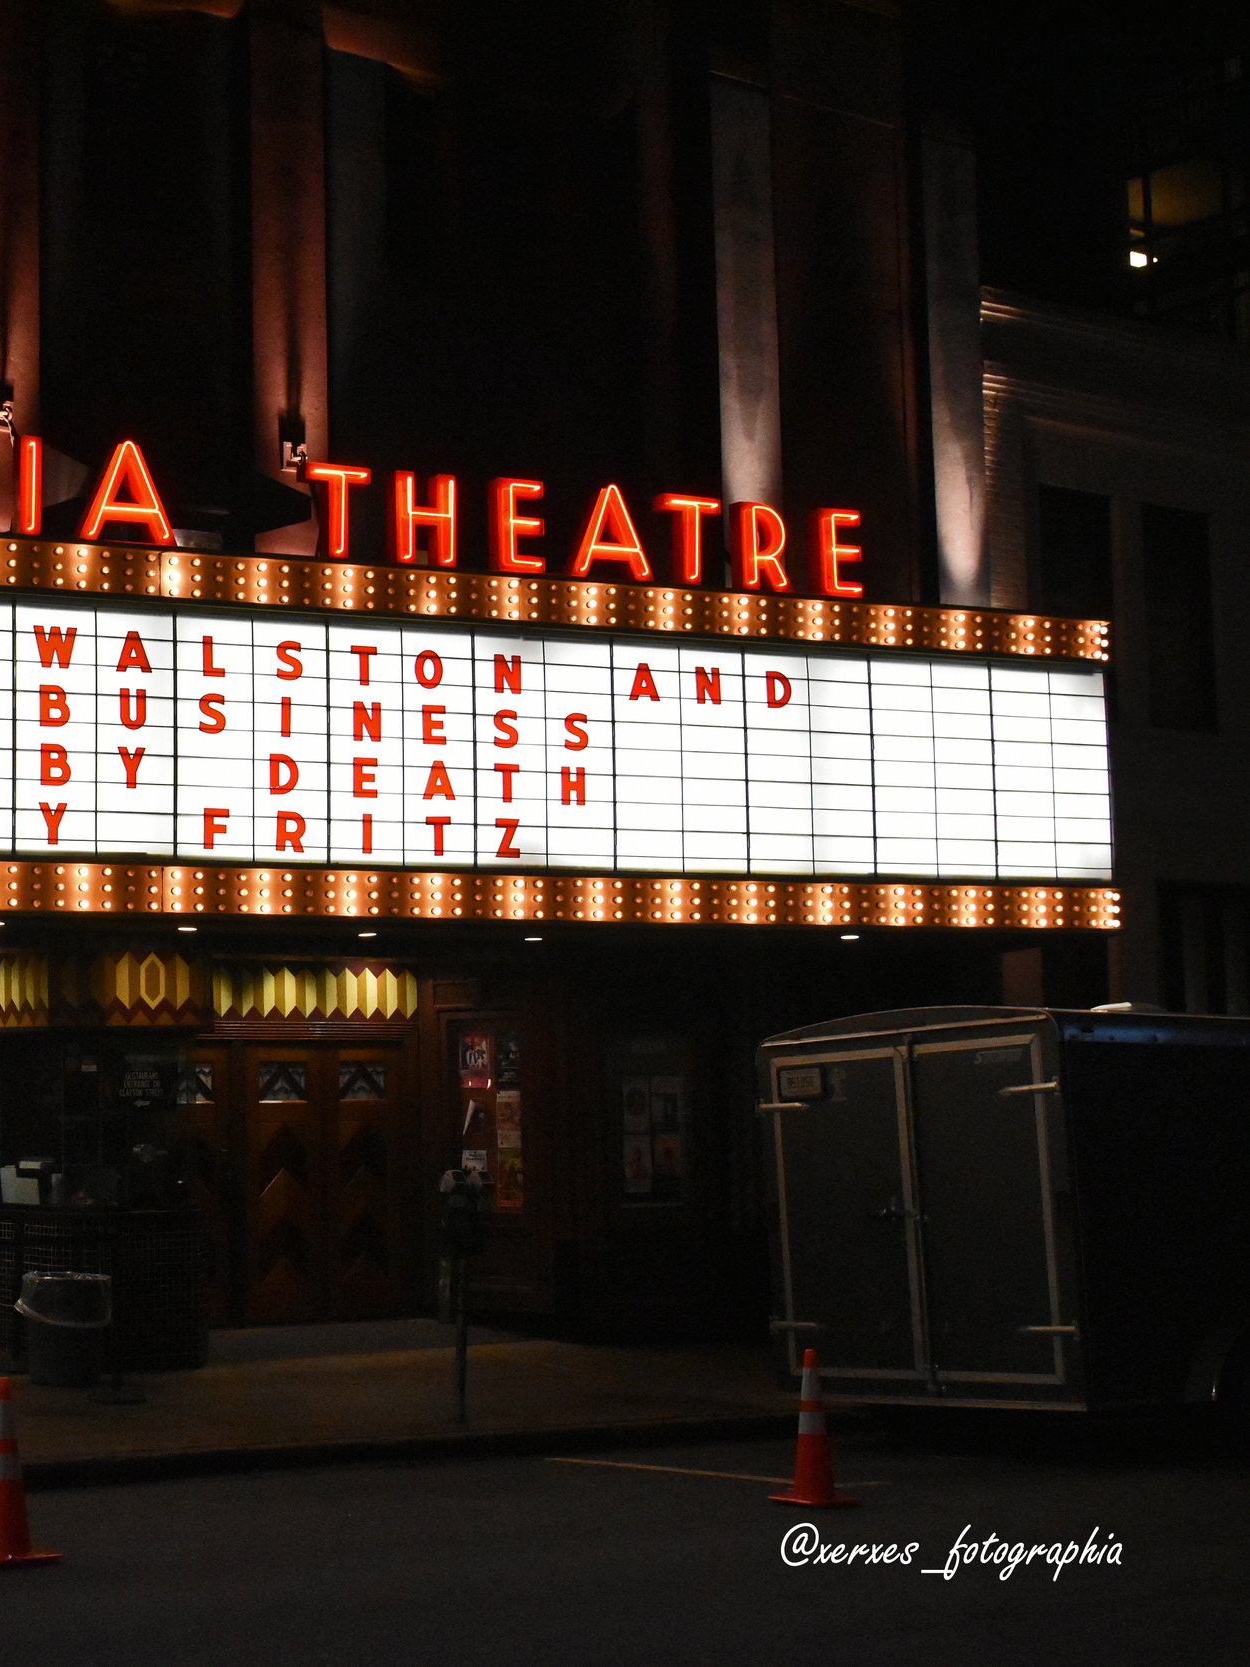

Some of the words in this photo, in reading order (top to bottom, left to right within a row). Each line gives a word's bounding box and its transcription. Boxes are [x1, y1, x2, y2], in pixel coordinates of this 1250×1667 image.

[297, 461, 863, 599] THEATRE
[34, 626, 522, 694] WALSTON
[630, 663, 791, 708] AND
[40, 685, 588, 751] BUSINESS
[41, 744, 146, 788] BY
[270, 754, 586, 805] DEATH
[204, 808, 520, 858] FRITZ
